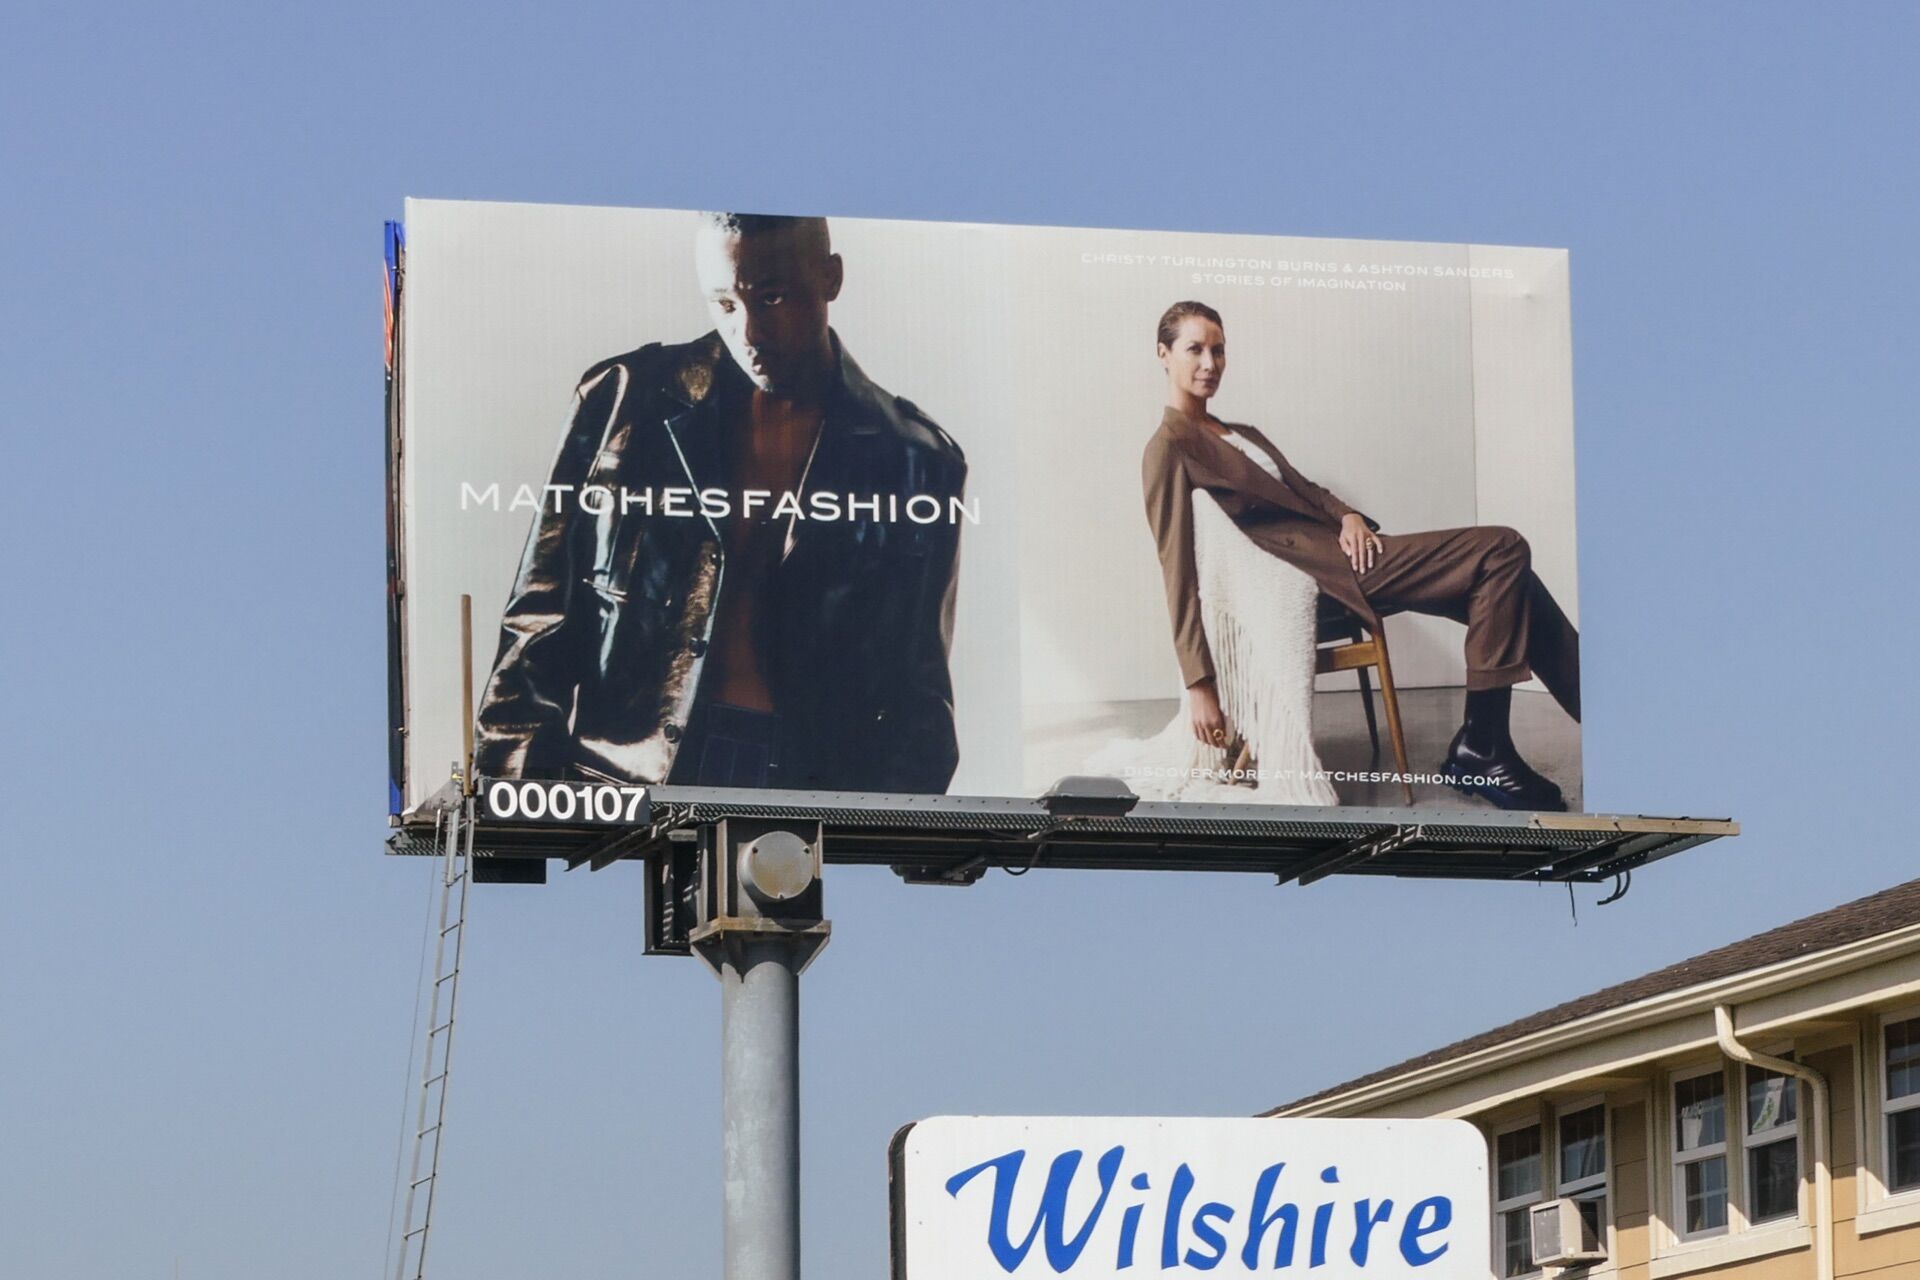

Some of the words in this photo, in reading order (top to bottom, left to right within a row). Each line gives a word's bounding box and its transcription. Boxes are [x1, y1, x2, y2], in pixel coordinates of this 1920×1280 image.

[1081, 252, 1157, 265] CHRISTY
[1161, 255, 1272, 270] TURLINGTON
[1278, 260, 1337, 273] BURNS
[1342, 263, 1354, 273] &
[1358, 264, 1428, 276] ASHTON
[1433, 266, 1514, 279] SANDERS
[1191, 273, 1265, 286] STORIES
[1270, 276, 1293, 287] OF
[1298, 277, 1406, 291] IMAGINATION
[1218, 768, 1269, 780] MORE
[1274, 769, 1294, 780] AT
[1301, 770, 1501, 787] MATCHESFASHION.COM
[489, 781, 645, 821] 000107
[945, 1145, 1452, 1274] Wilshire
